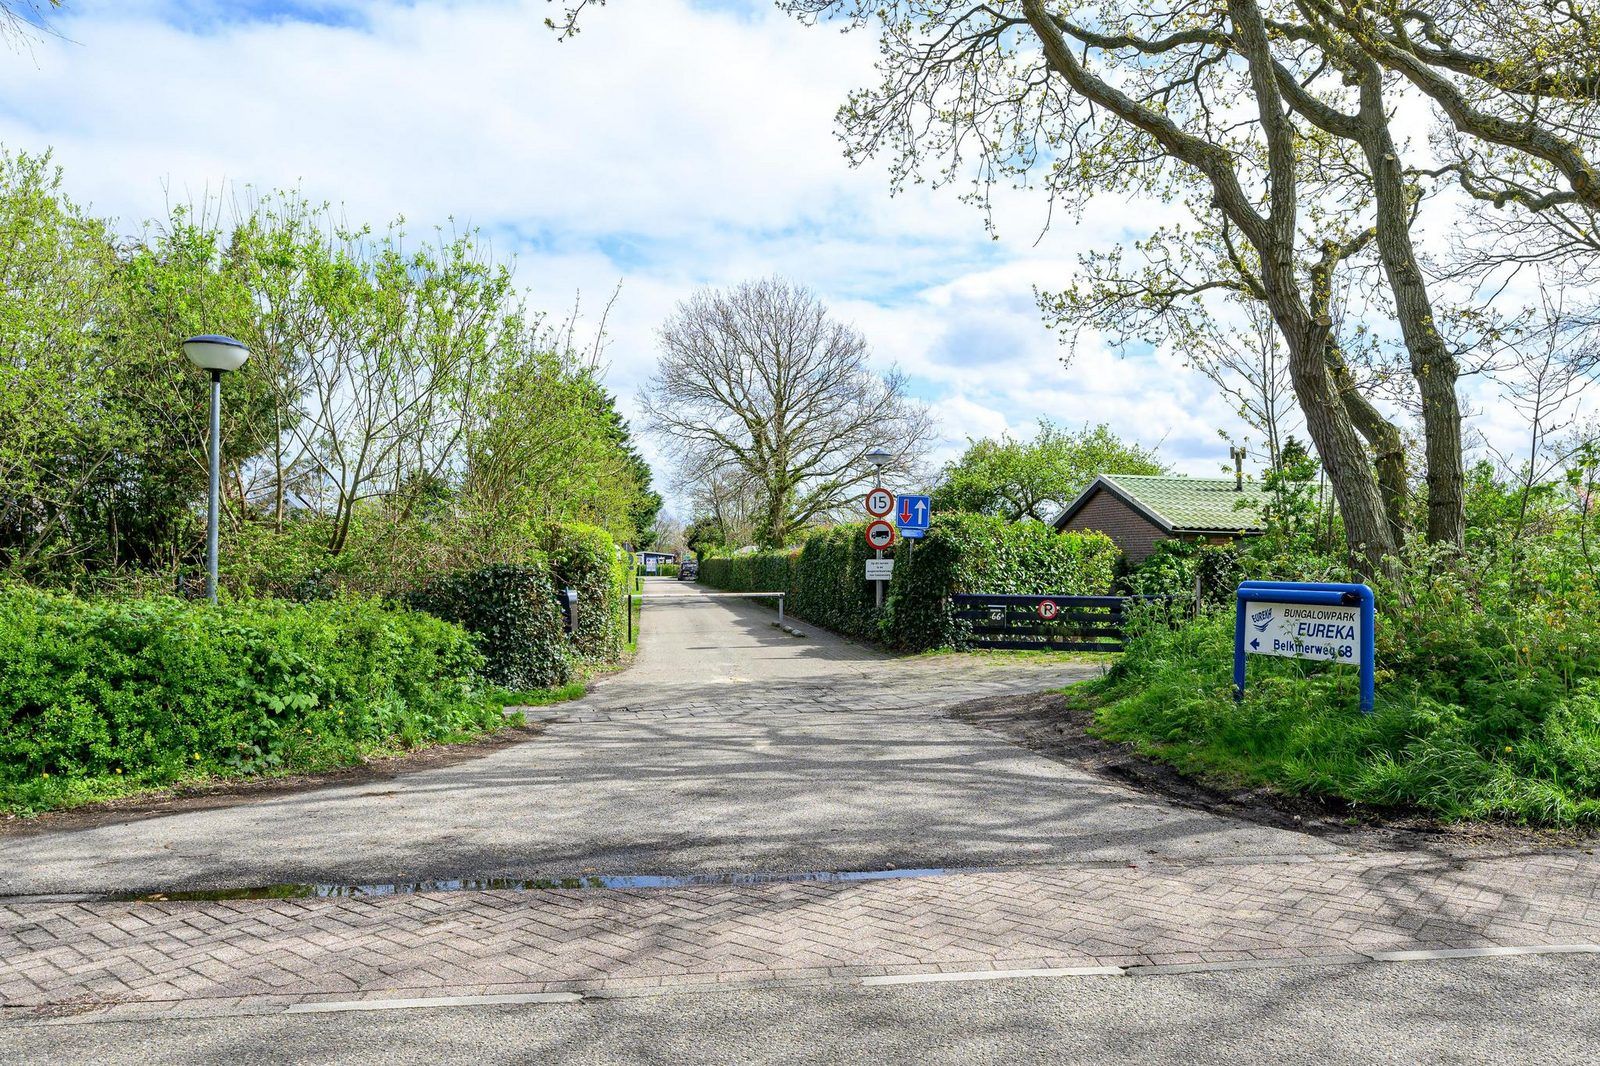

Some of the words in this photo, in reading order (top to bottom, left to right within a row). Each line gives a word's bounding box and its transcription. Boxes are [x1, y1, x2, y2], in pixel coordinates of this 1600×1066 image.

[872, 496, 886, 509] 15
[1252, 608, 1273, 624] EUREKA
[1284, 608, 1356, 622] BUNGALOWPARK
[1298, 622, 1355, 640] EUREKA
[1274, 639, 1335, 659] Belkmerweg
[1338, 644, 1352, 658] 68
